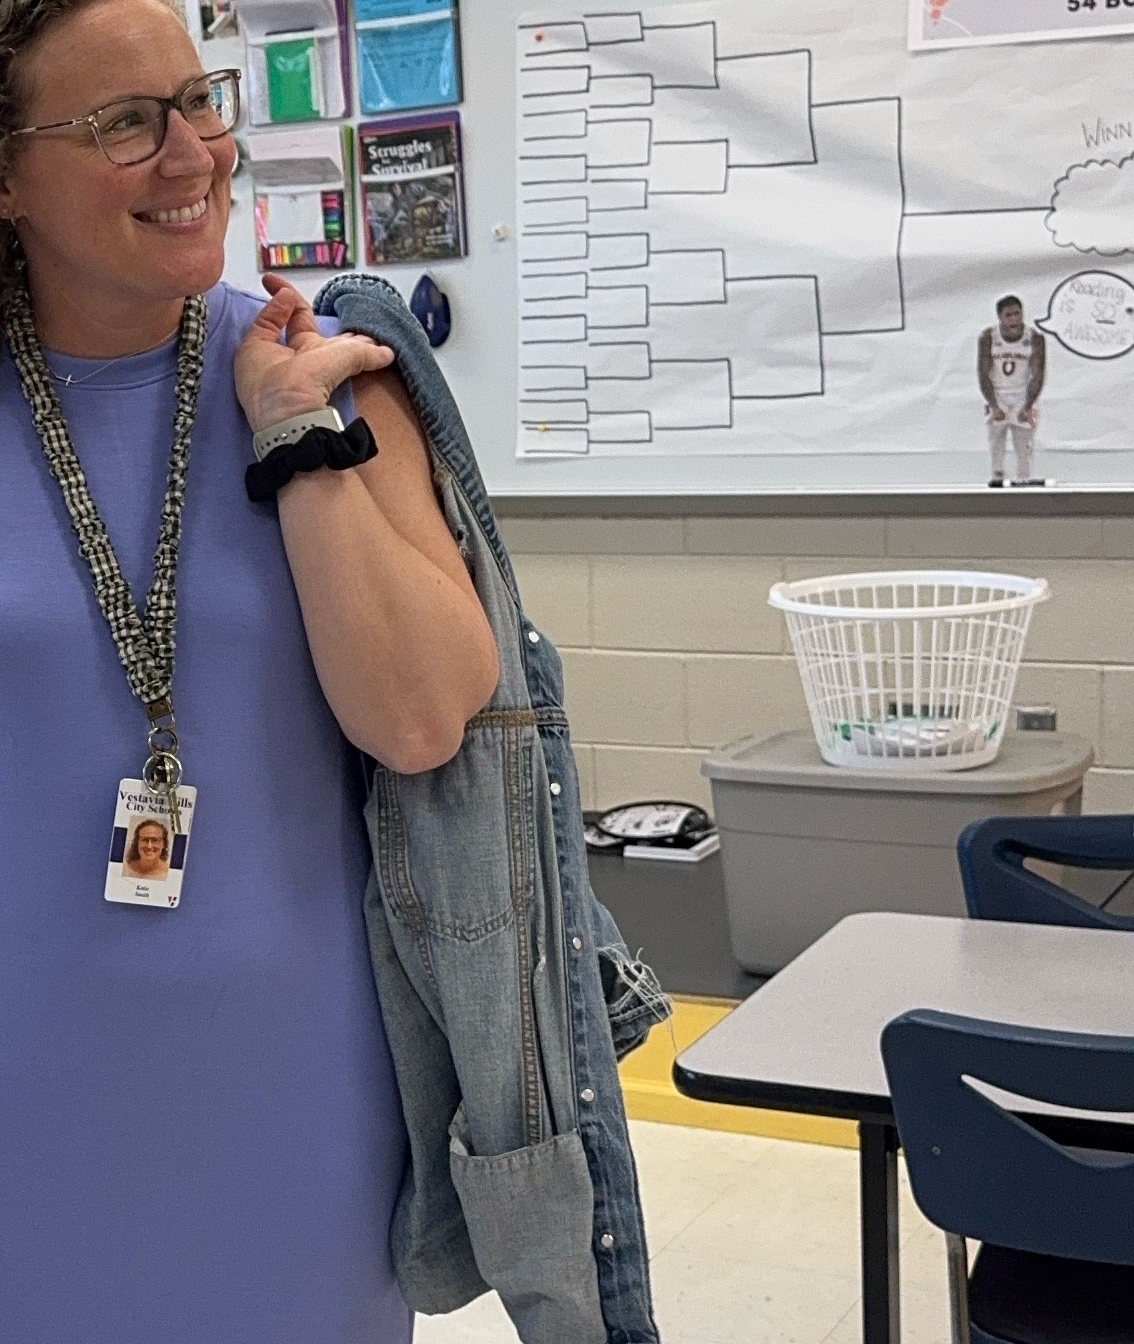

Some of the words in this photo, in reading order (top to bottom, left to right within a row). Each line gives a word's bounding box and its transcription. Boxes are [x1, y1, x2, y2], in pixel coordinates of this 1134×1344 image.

[368, 140, 432, 160] Struggles
[120, 791, 164, 805] Vestavia
[126, 801, 145, 813] City
[148, 804, 182, 815] Schos
